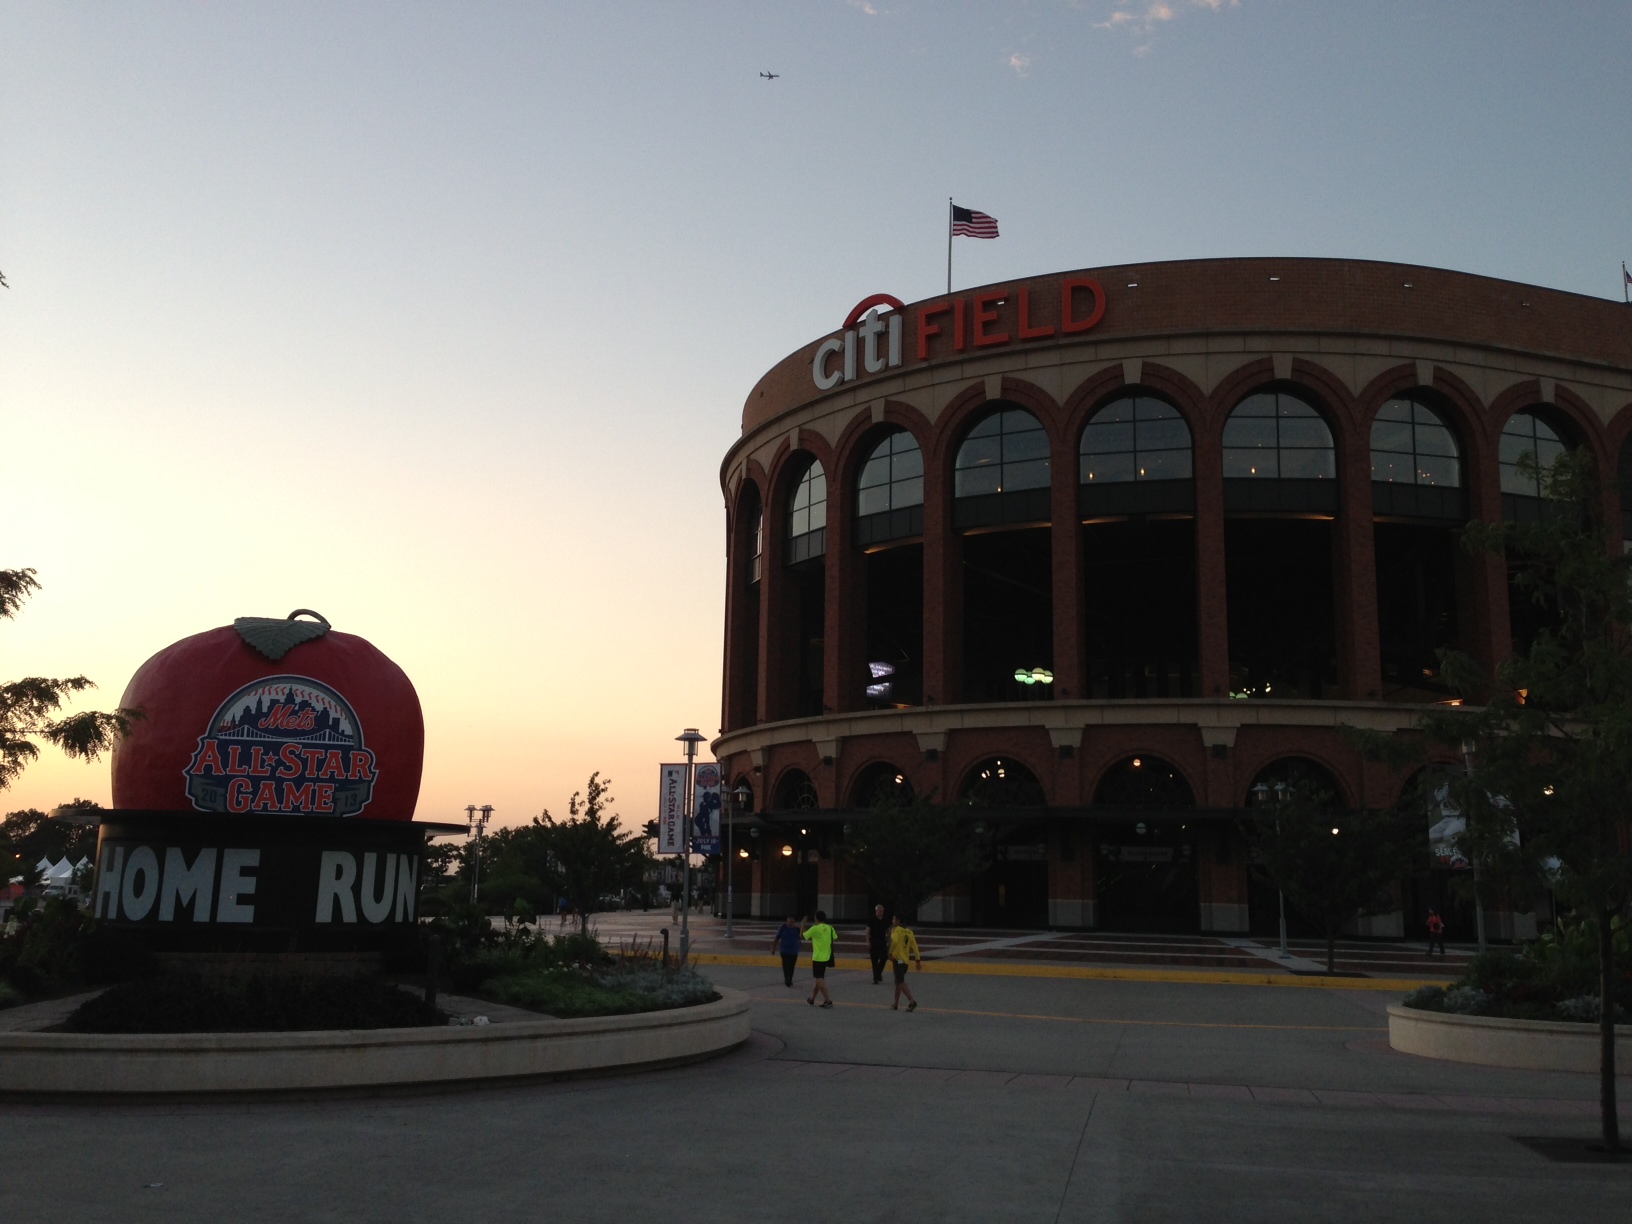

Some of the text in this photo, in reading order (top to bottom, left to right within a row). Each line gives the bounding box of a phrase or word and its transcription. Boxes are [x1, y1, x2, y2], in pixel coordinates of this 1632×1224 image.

[812, 277, 1107, 391] citi FIELD
[259, 704, 317, 730] Mets
[201, 788, 217, 803] 20
[226, 778, 336, 813] GAME
[344, 793, 358, 808] 13
[667, 821, 675, 847] GAME
[95, 844, 419, 924] HOME RUN
